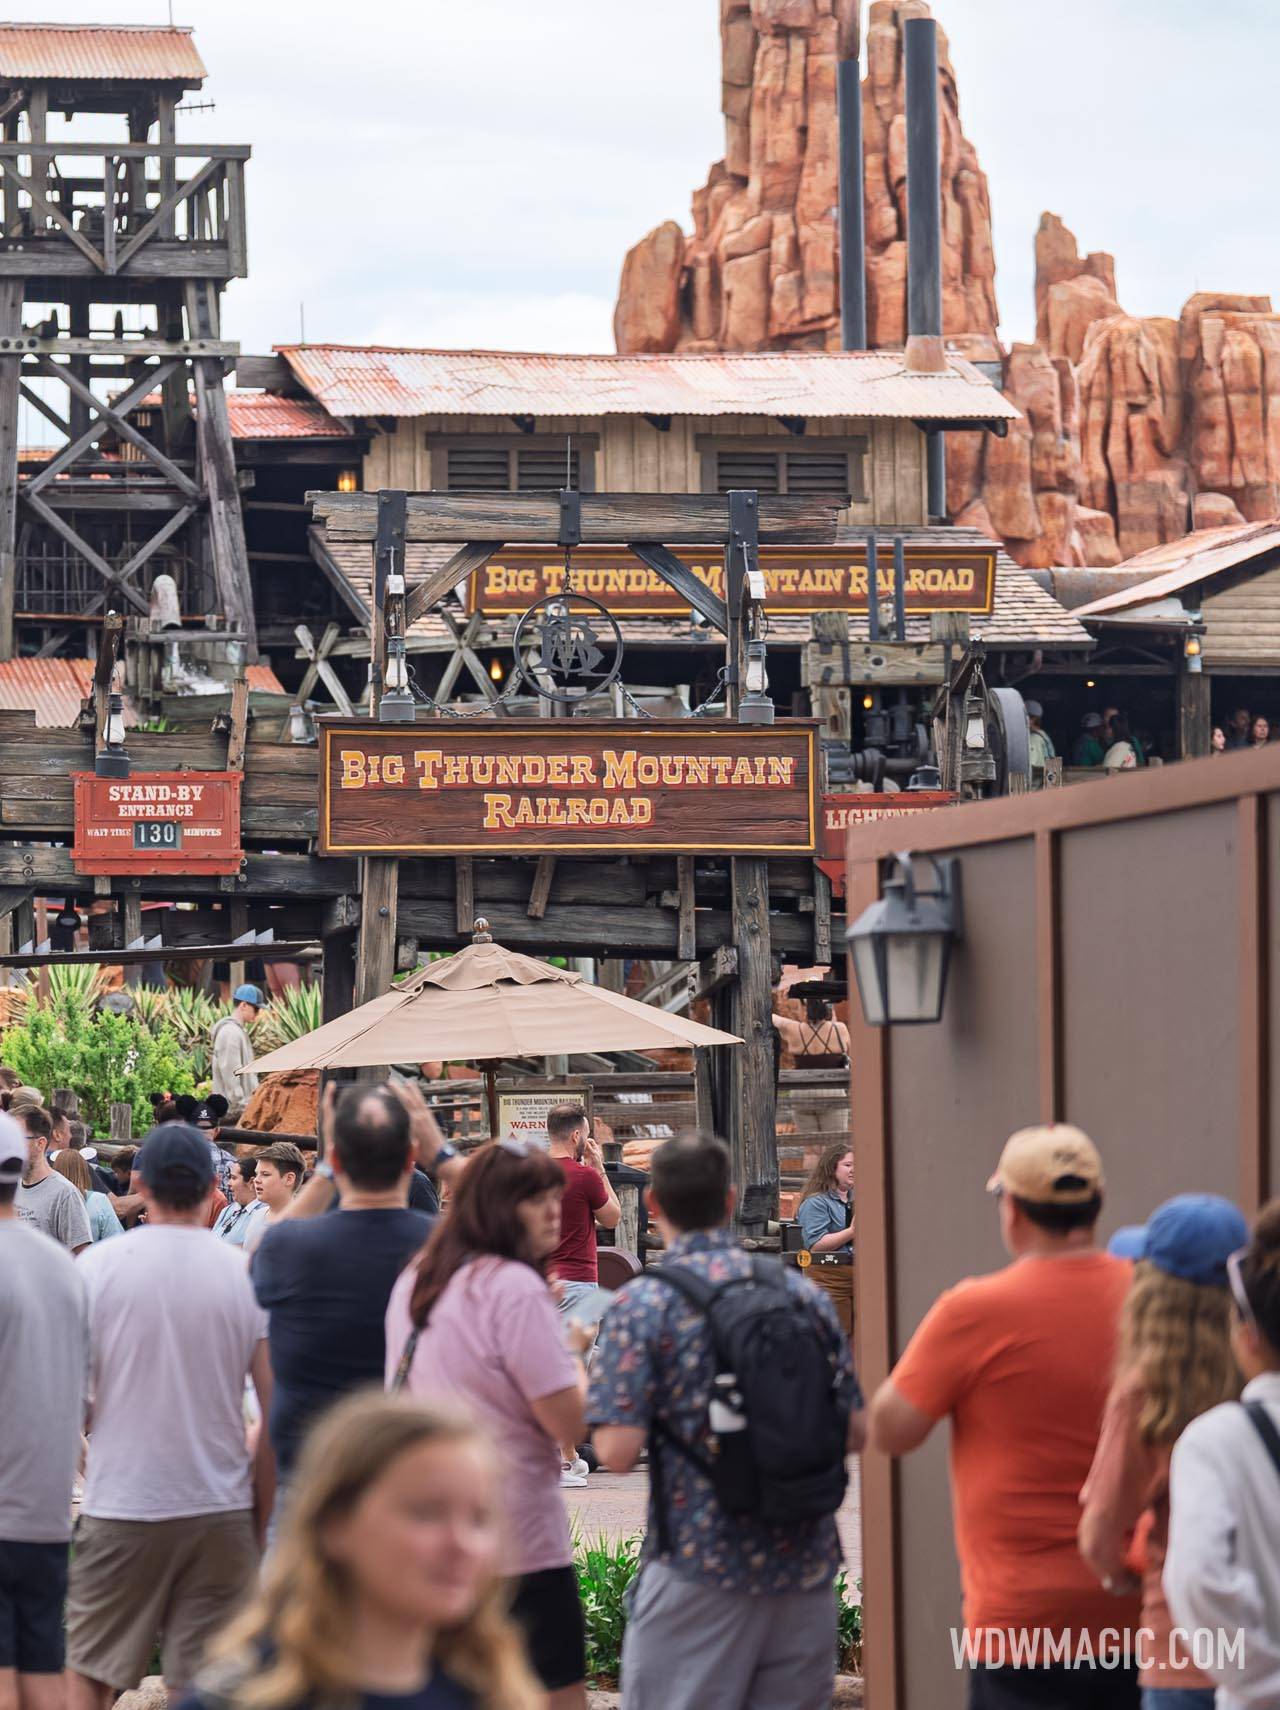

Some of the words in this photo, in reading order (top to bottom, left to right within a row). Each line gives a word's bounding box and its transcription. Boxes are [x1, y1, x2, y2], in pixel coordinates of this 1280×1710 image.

[485, 566, 537, 594] BIG
[543, 566, 677, 594] THUNDE
[690, 565, 843, 593] MNTAIN
[341, 751, 405, 788] BIG
[415, 751, 596, 788] THUNDER
[603, 751, 793, 788] MOUNTAIN
[109, 785, 204, 801] STAND-BY
[119, 804, 193, 817] ENTRANCE
[484, 794, 652, 828] RAILROAD
[87, 828, 108, 837] WAIT
[110, 829, 132, 837] TIME
[138, 823, 175, 843] 130
[183, 828, 222, 837] MINUTES
[510, 1121, 546, 1129] WARN
